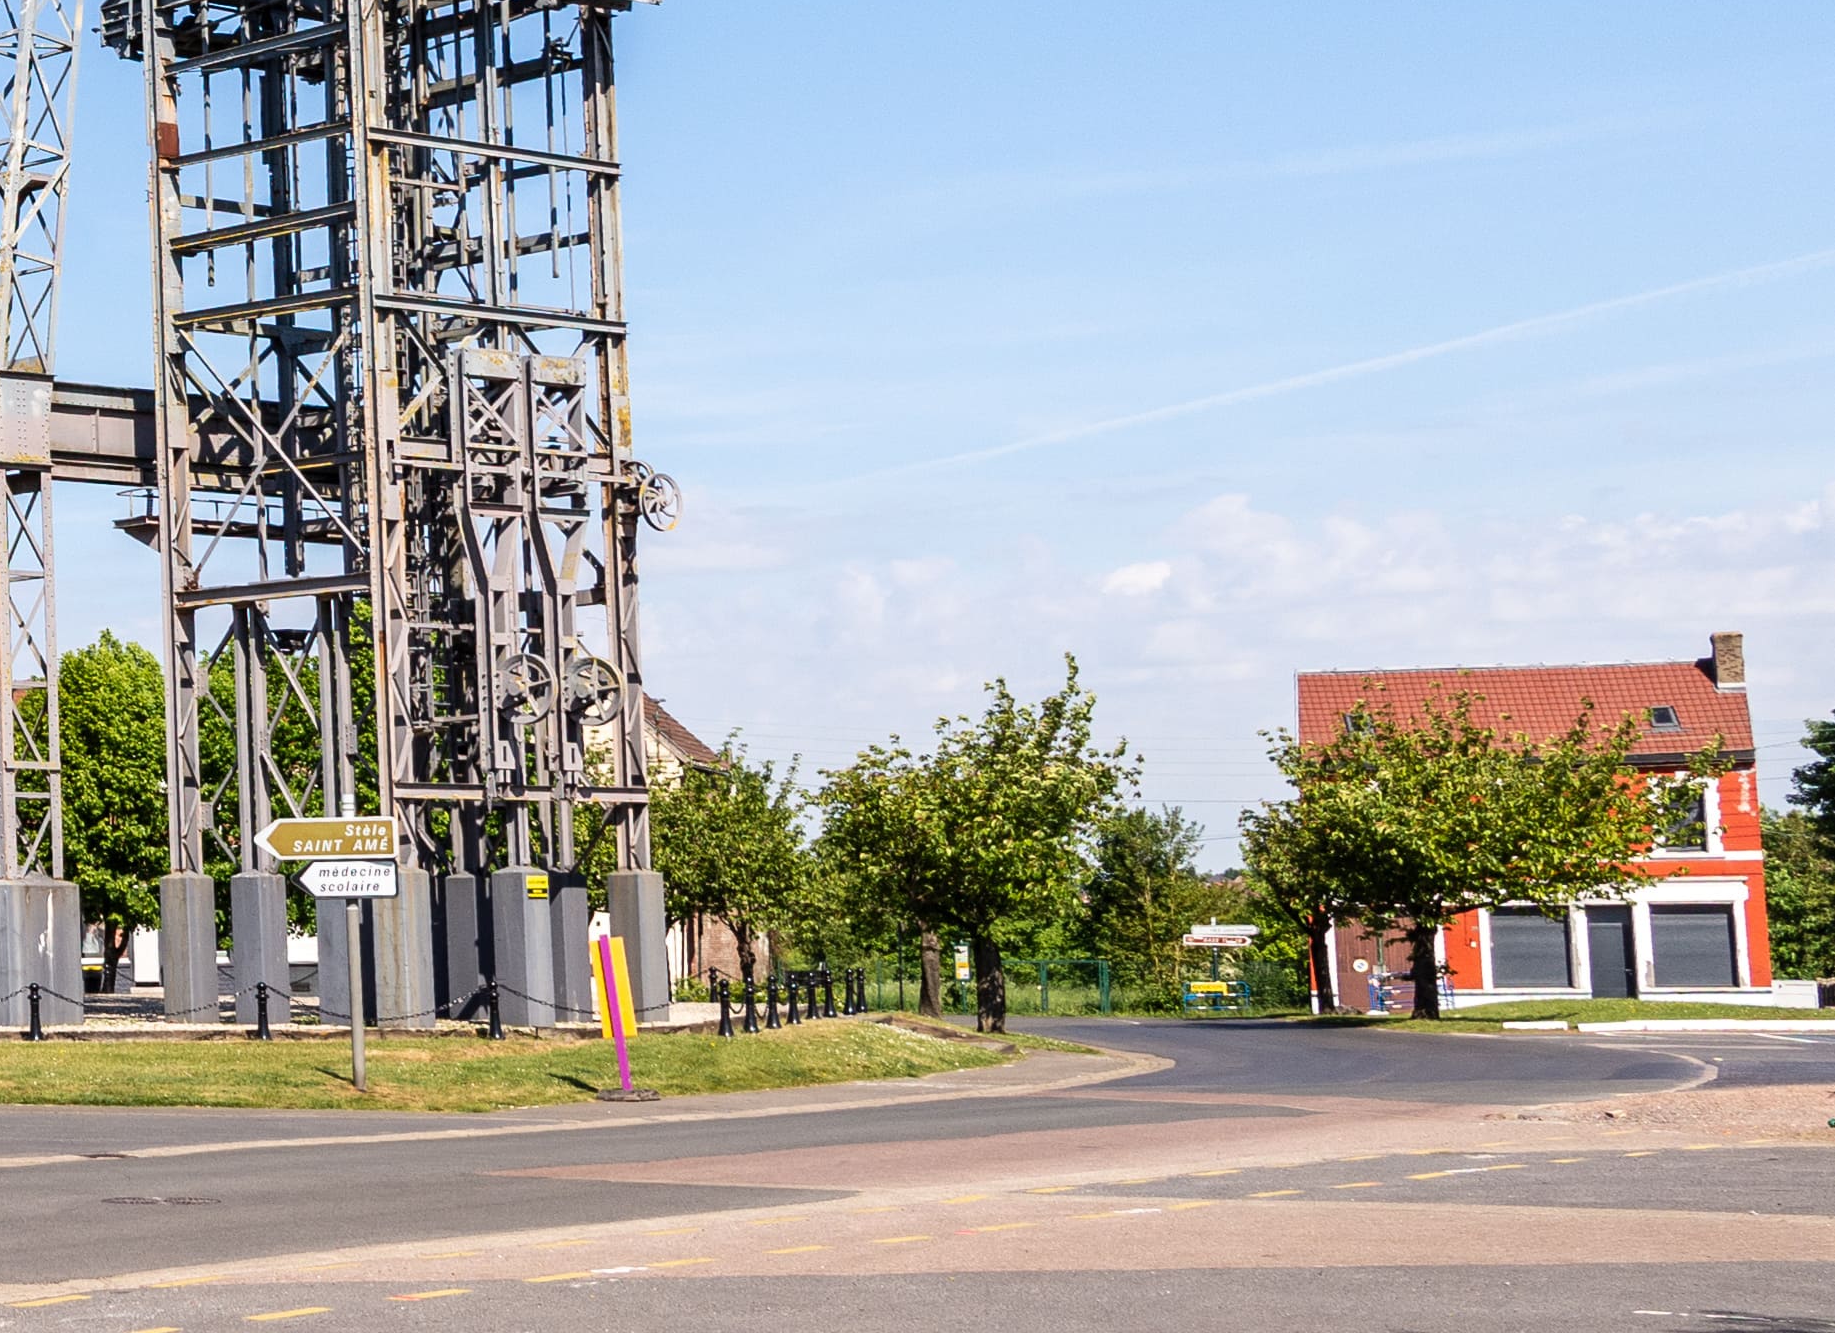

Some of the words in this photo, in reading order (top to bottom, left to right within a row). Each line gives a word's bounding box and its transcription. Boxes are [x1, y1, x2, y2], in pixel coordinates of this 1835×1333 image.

[344, 824, 387, 837] Stèle
[293, 839, 343, 853] SAINT
[353, 837, 389, 851] AMÉ
[319, 866, 391, 878] médecine
[320, 882, 380, 893] scolaire
